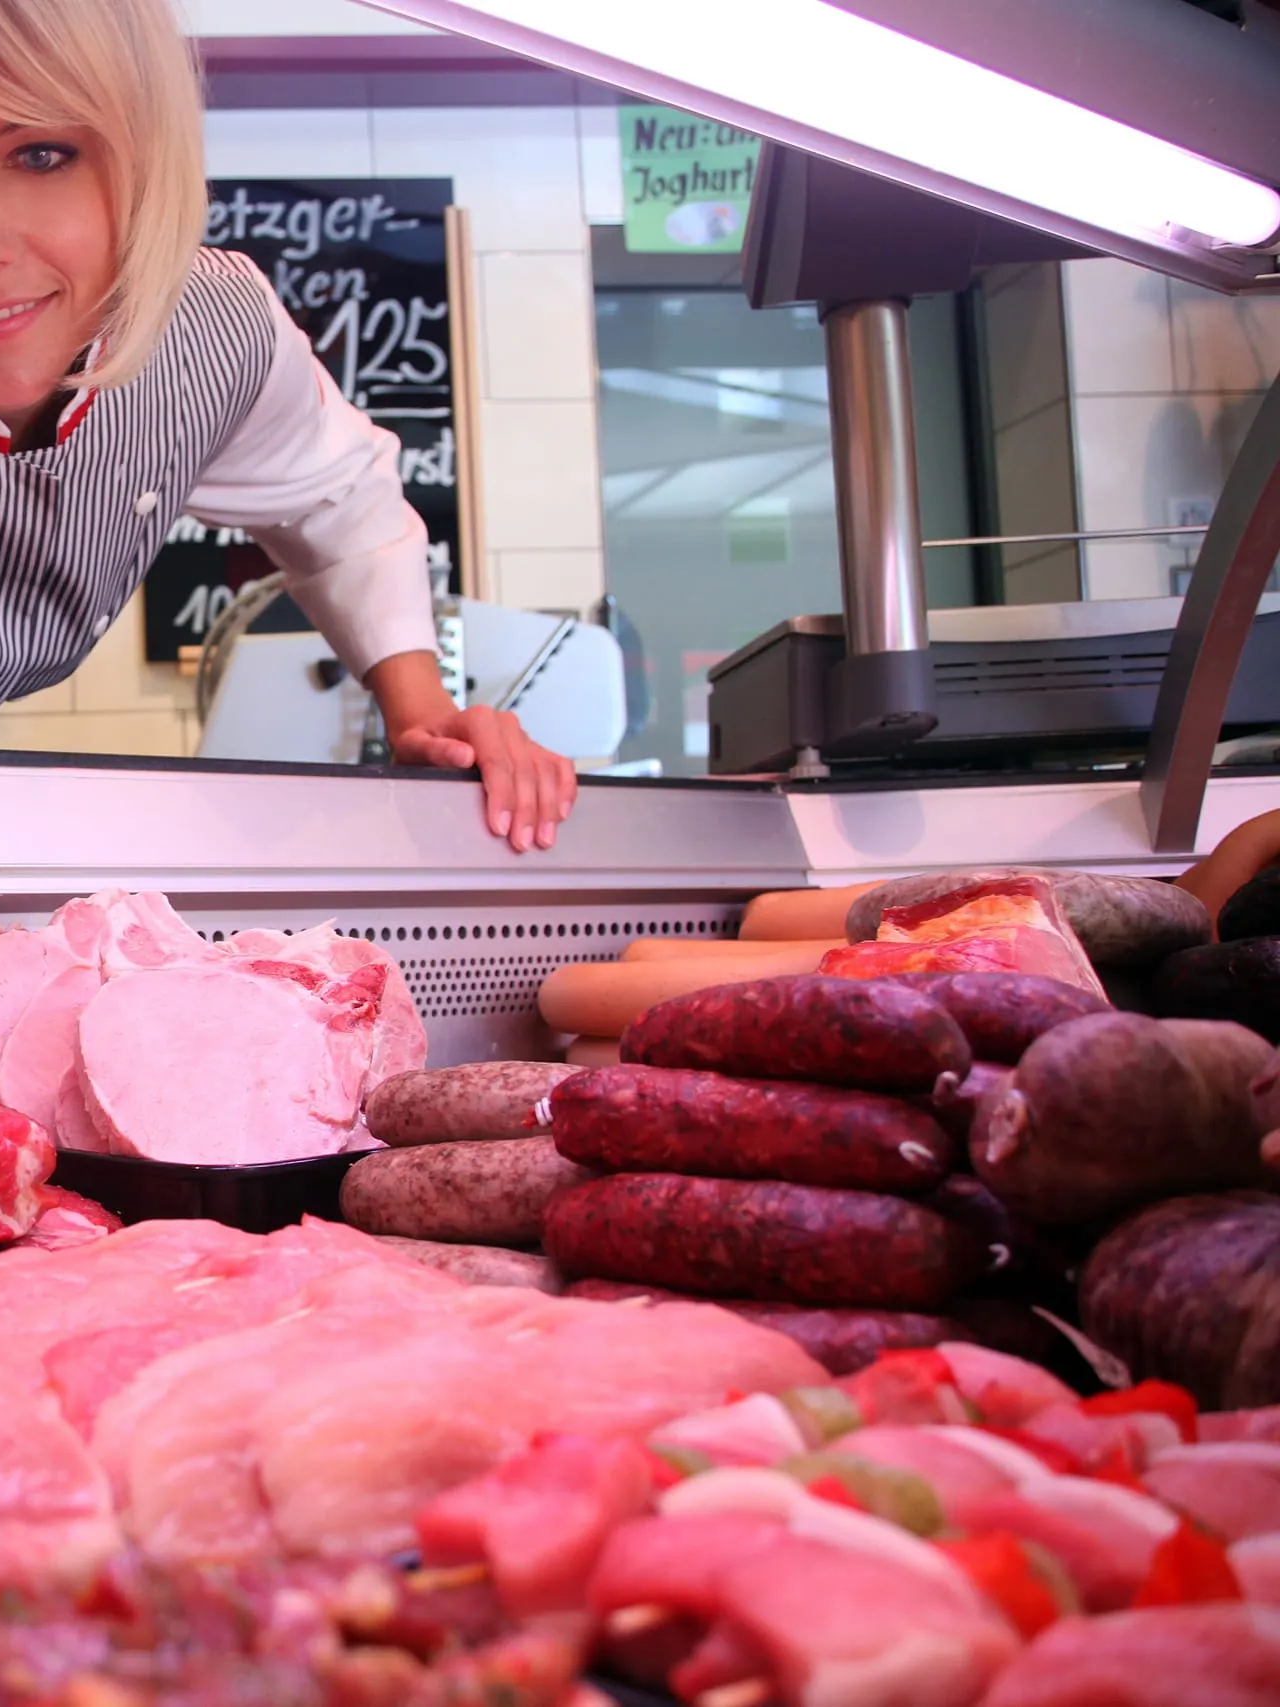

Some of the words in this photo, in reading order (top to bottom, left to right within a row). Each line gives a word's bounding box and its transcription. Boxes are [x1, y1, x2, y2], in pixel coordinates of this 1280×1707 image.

[633, 156, 754, 207] Joghurt
[204, 187, 419, 261] etzger-
[269, 259, 370, 310] ken
[401, 427, 456, 487] rst
